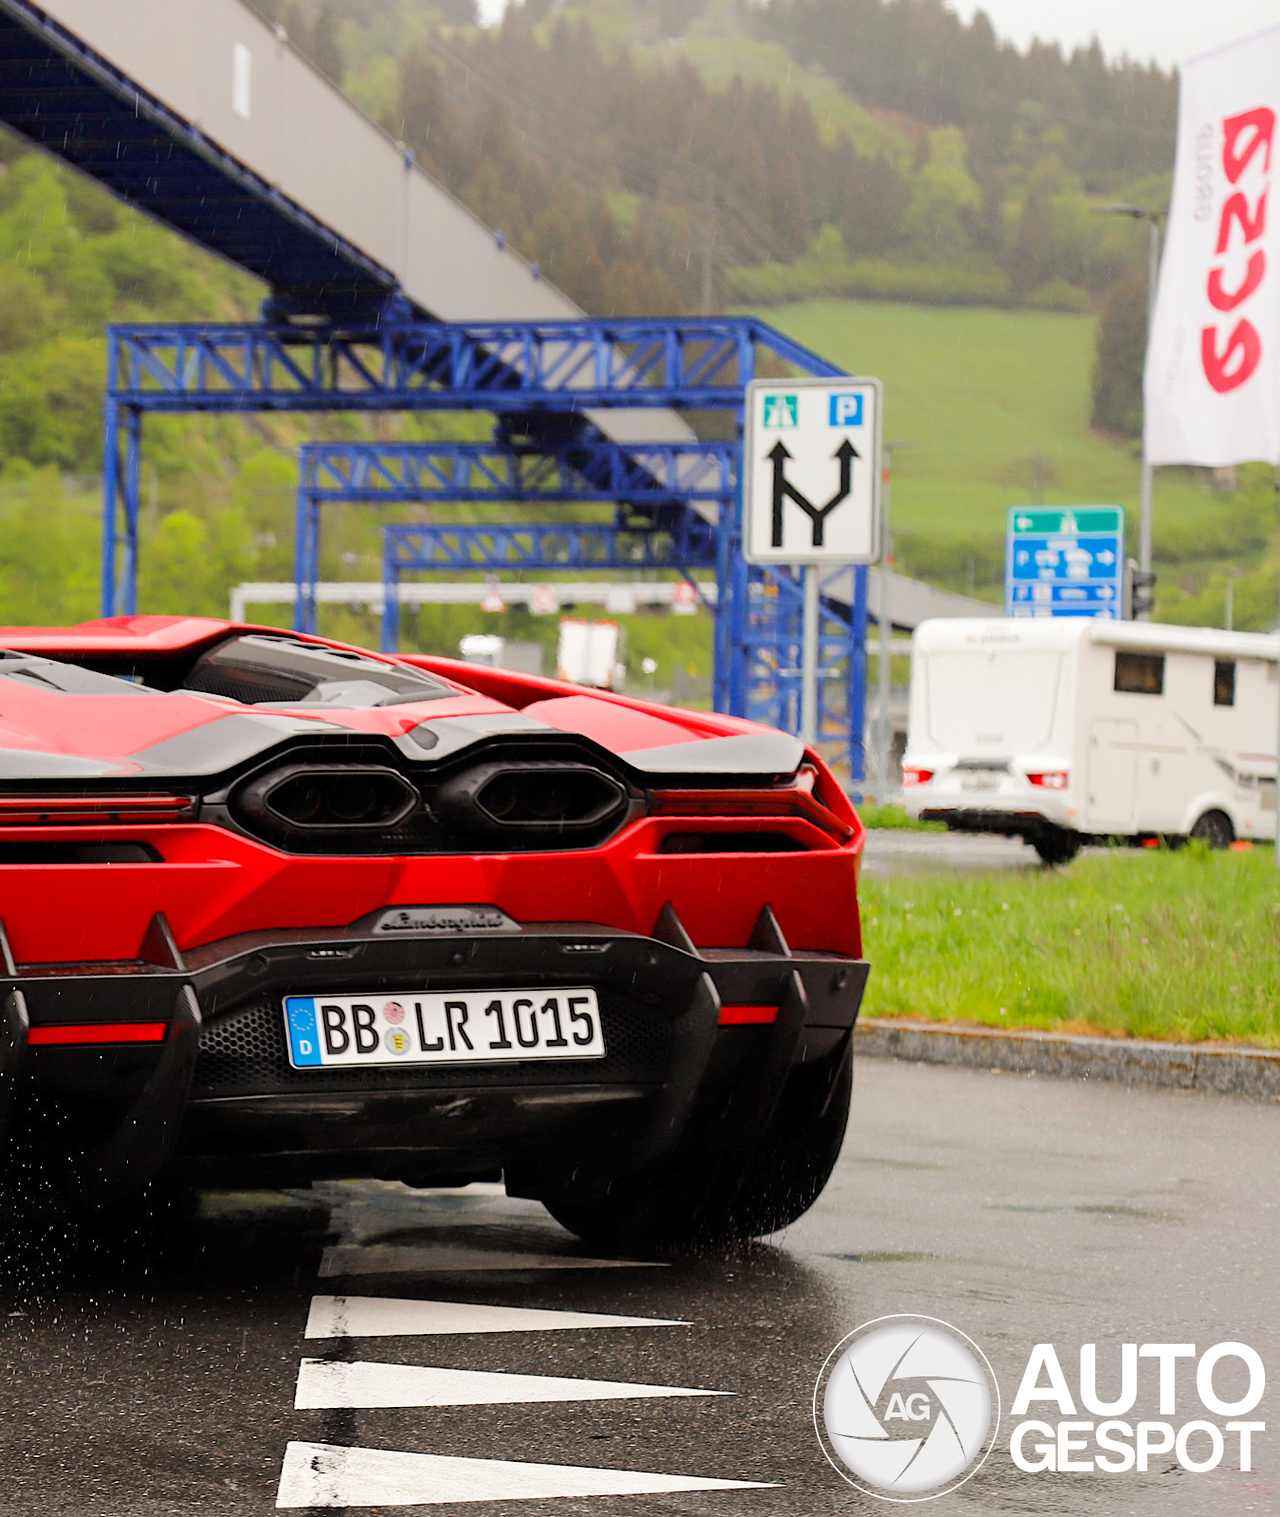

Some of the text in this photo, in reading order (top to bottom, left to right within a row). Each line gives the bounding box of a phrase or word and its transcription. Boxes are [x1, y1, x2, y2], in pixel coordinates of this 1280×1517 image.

[837, 396, 858, 425] P
[321, 997, 595, 1055] BB LR 1015
[299, 1039, 313, 1056] D
